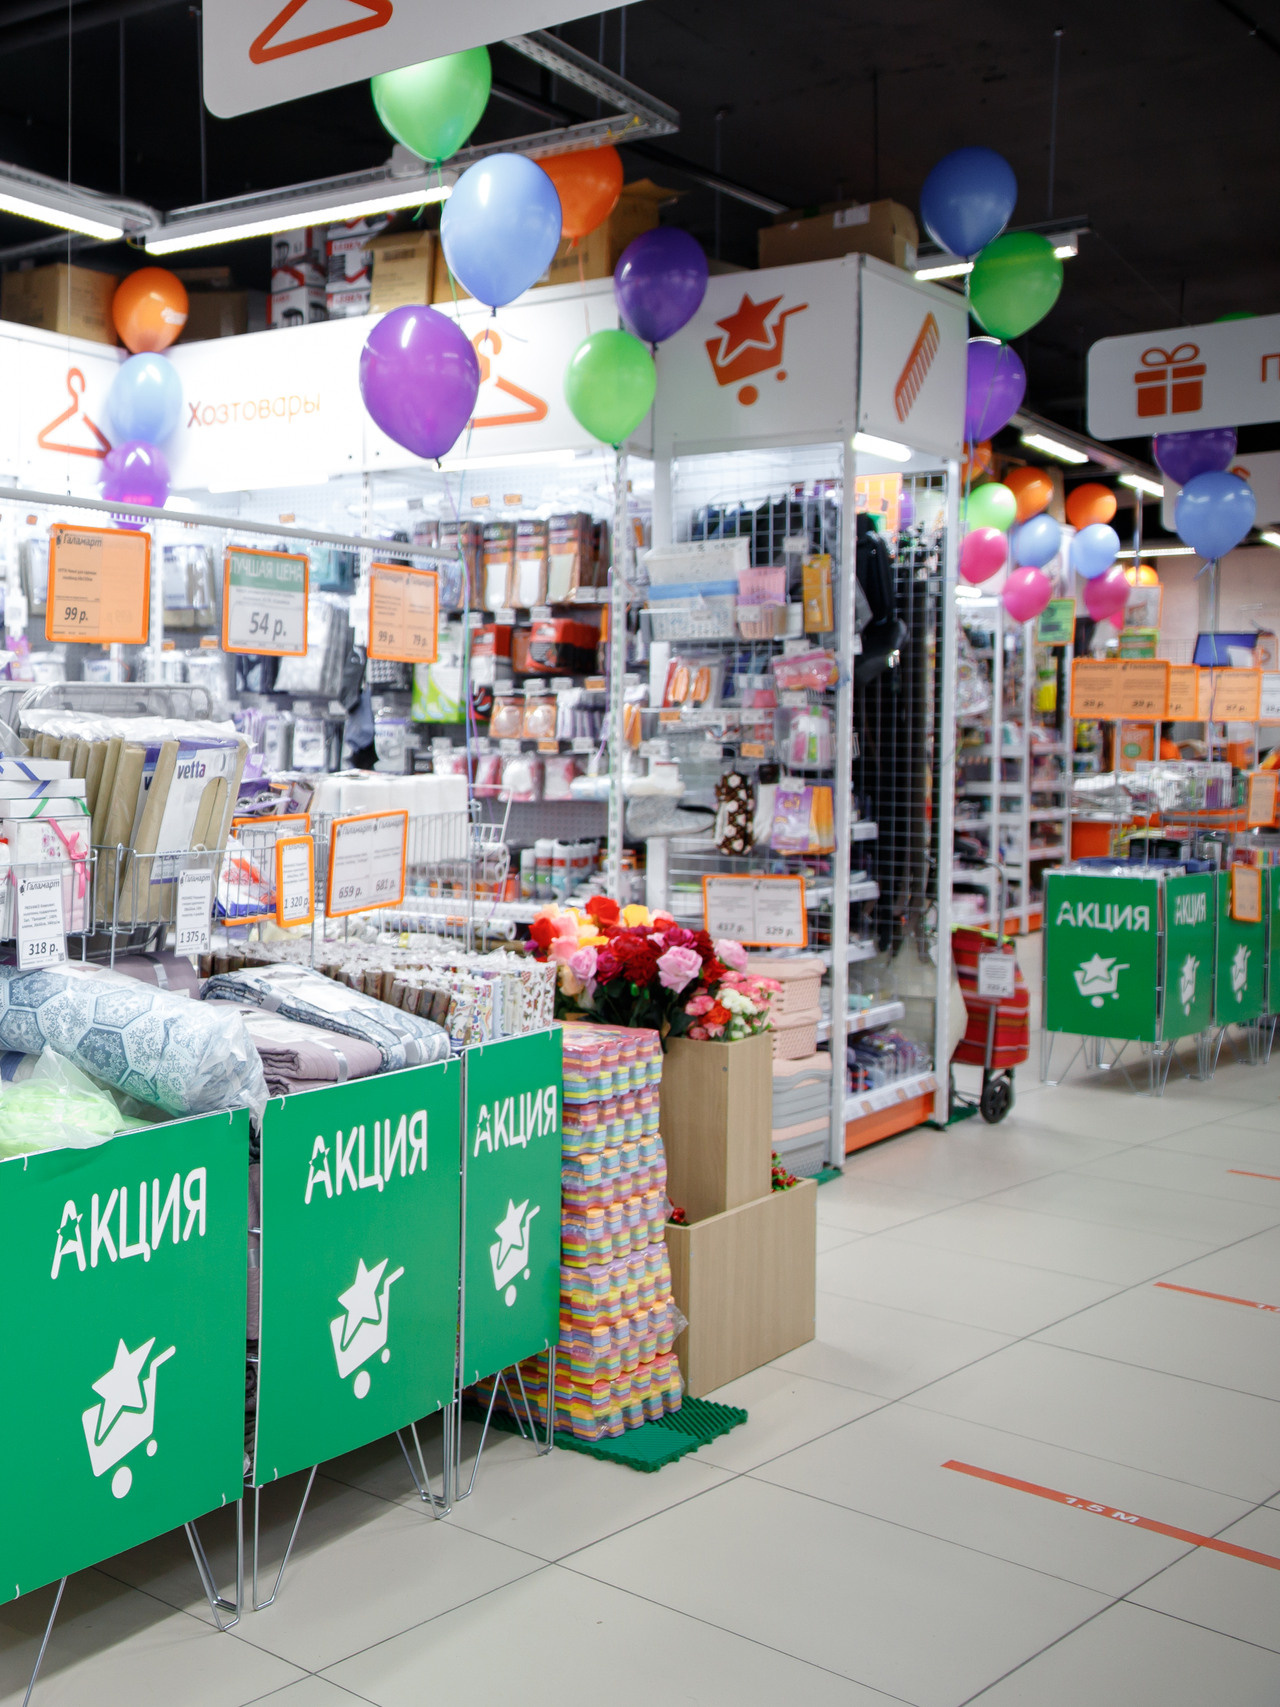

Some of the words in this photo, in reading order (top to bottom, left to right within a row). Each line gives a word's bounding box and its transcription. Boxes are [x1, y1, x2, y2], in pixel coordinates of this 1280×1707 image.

[187, 393, 320, 428] Хозтовары
[63, 534, 102, 550] Галамарт
[230, 556, 273, 578] ЛУЧШАЯ
[276, 562, 304, 582] ЦЕНА
[64, 607, 78, 621] 99
[79, 610, 88, 624] р.
[248, 612, 269, 635] 54
[272, 618, 287, 641] р.
[378, 630, 387, 641] 99
[387, 634, 395, 645] р.
[177, 761, 206, 779] vetta
[26, 880, 60, 892] Галамарт
[185, 873, 210, 884] Галамарт
[338, 885, 355, 899] 659
[354, 886, 363, 898] р.
[290, 896, 303, 908] 320
[1174, 892, 1207, 927] АКЦИЯ
[1056, 900, 1150, 933] АКЦИЯ
[180, 932, 184, 943] 1
[186, 931, 199, 943] 375
[200, 932, 207, 943] р.
[28, 942, 47, 956] 318
[49, 942, 59, 956] р.
[474, 1085, 558, 1158] АКЦИЯ
[304, 1109, 428, 1204] АКЦИЯ
[50, 1166, 207, 1280] АКЦИЯ
